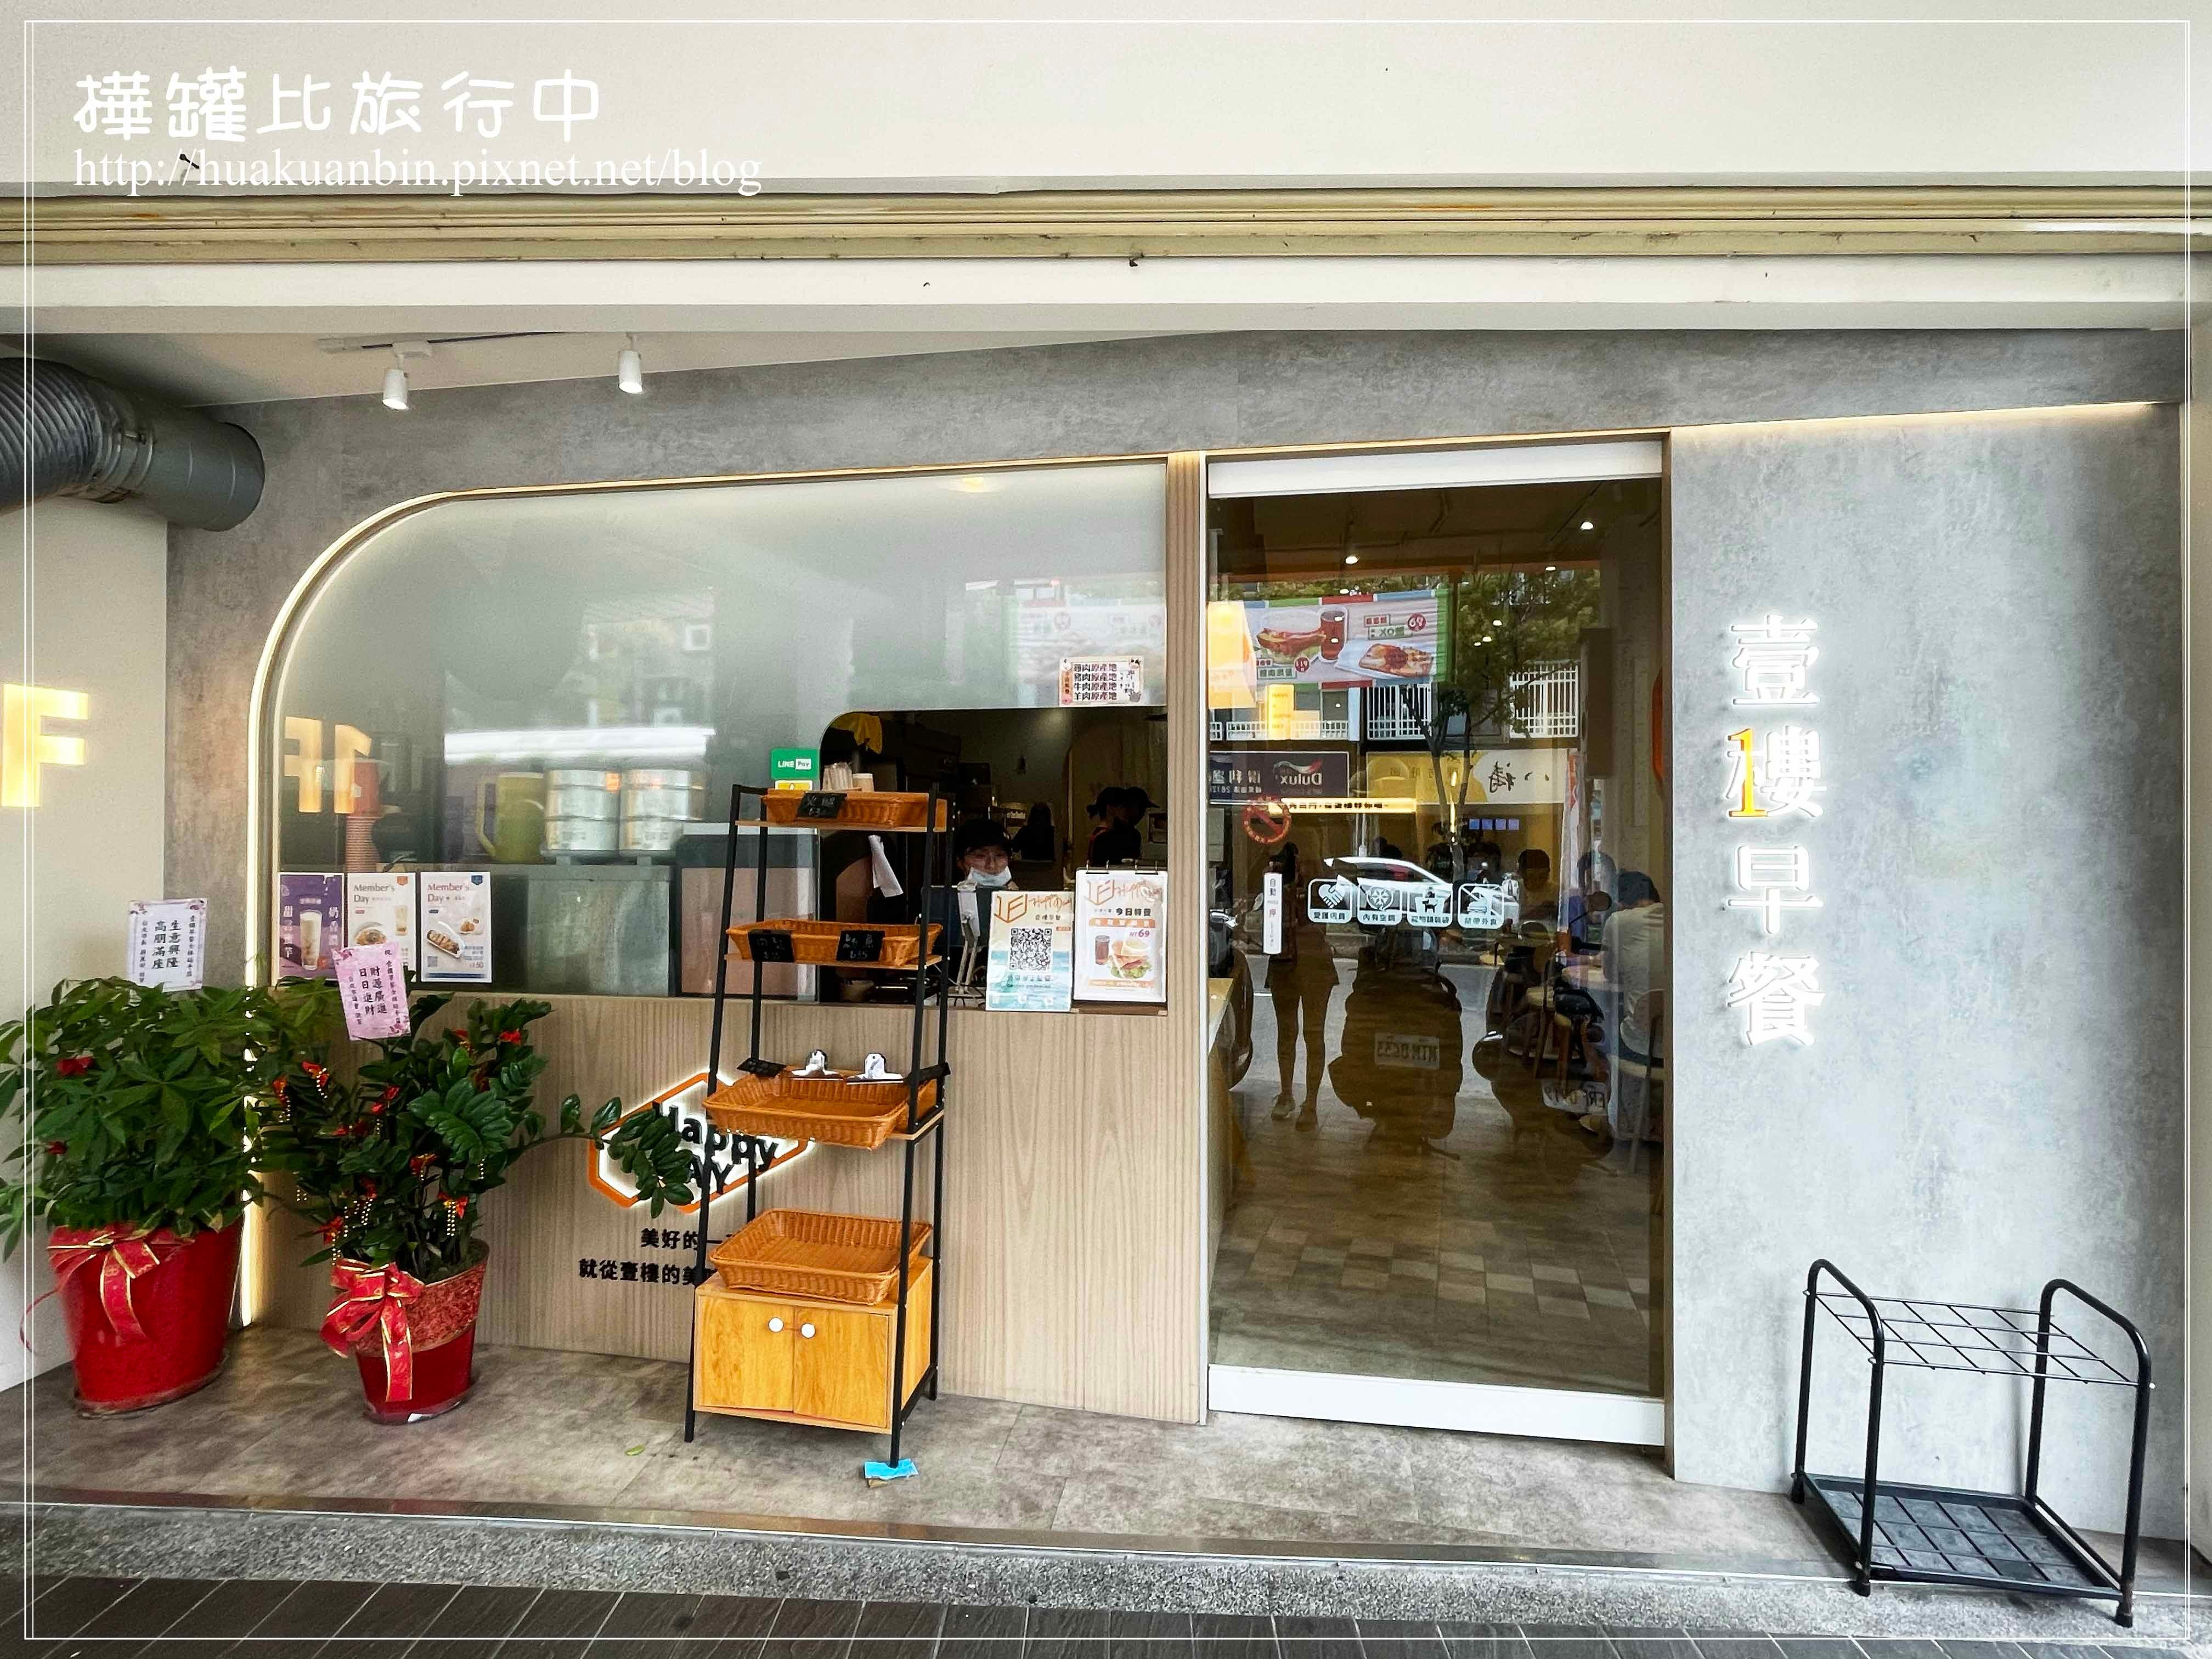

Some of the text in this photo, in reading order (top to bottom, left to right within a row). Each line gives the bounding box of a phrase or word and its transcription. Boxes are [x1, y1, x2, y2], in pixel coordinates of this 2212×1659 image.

[1074, 682, 1118, 691] 牛肉原產地
[1074, 691, 1118, 701] 羊肉原產地
[777, 760, 795, 768] LINE
[1724, 614, 1827, 1047] 壹樓早餐
[427, 883, 470, 891] Member's
[353, 894, 369, 904] Day
[427, 893, 445, 904] Day
[151, 920, 167, 970] 高朋滿座
[166, 919, 182, 968] 生意興隆
[640, 1227, 734, 1251] 美好的一
